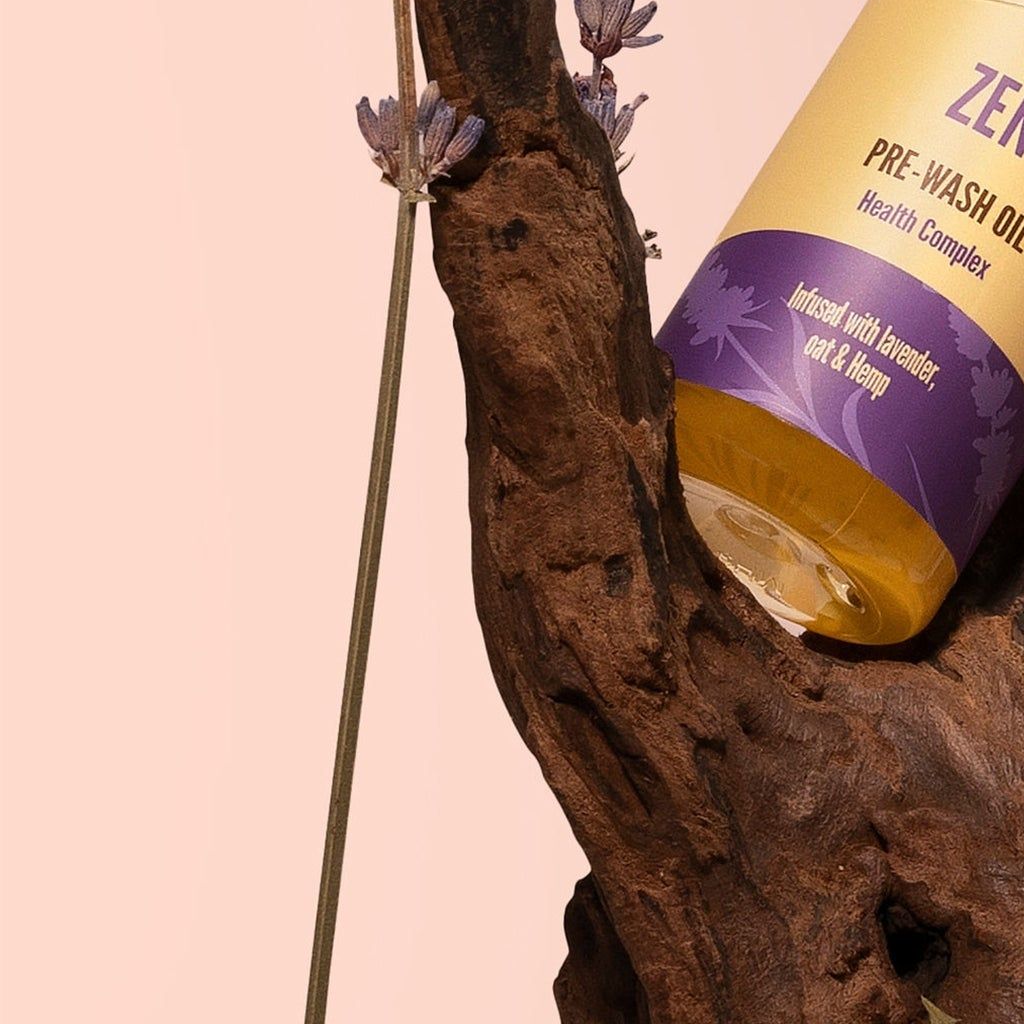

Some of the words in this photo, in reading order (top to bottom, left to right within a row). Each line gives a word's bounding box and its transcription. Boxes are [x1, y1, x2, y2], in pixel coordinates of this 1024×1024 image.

[862, 138, 997, 225] PRE-WASH
[857, 189, 916, 234] Health
[919, 219, 991, 280] Complex
[787, 282, 850, 328] Infused
[843, 310, 880, 346] with
[875, 326, 940, 392] lavender,
[804, 334, 836, 365] oat
[831, 343, 851, 371] &
[845, 351, 891, 401] Hemp
